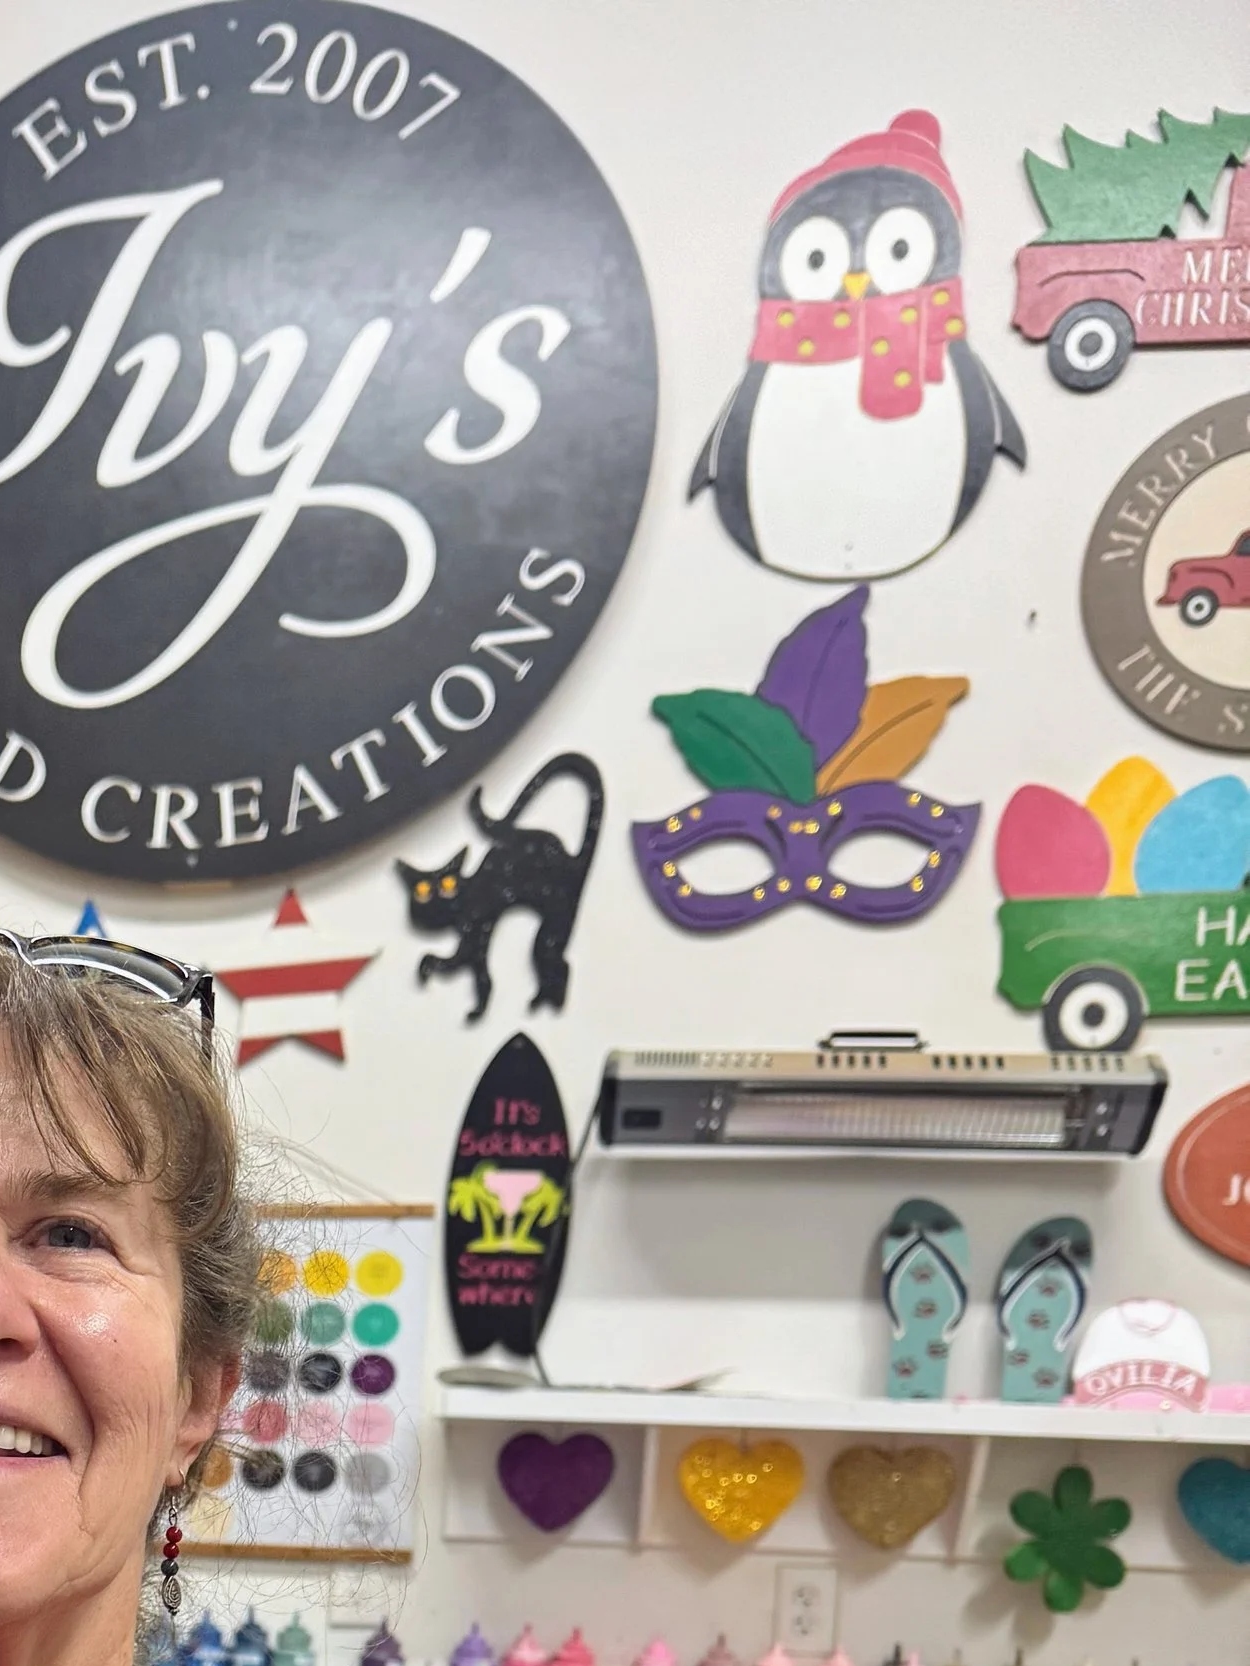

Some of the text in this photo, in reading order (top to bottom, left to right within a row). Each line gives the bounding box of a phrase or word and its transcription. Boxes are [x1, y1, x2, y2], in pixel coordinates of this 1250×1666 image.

[11, 21, 461, 180] EST. 2007
[1101, 424, 1218, 568] MERRY
[80, 546, 587, 851] CREATIONS
[1117, 644, 1202, 716] THE
